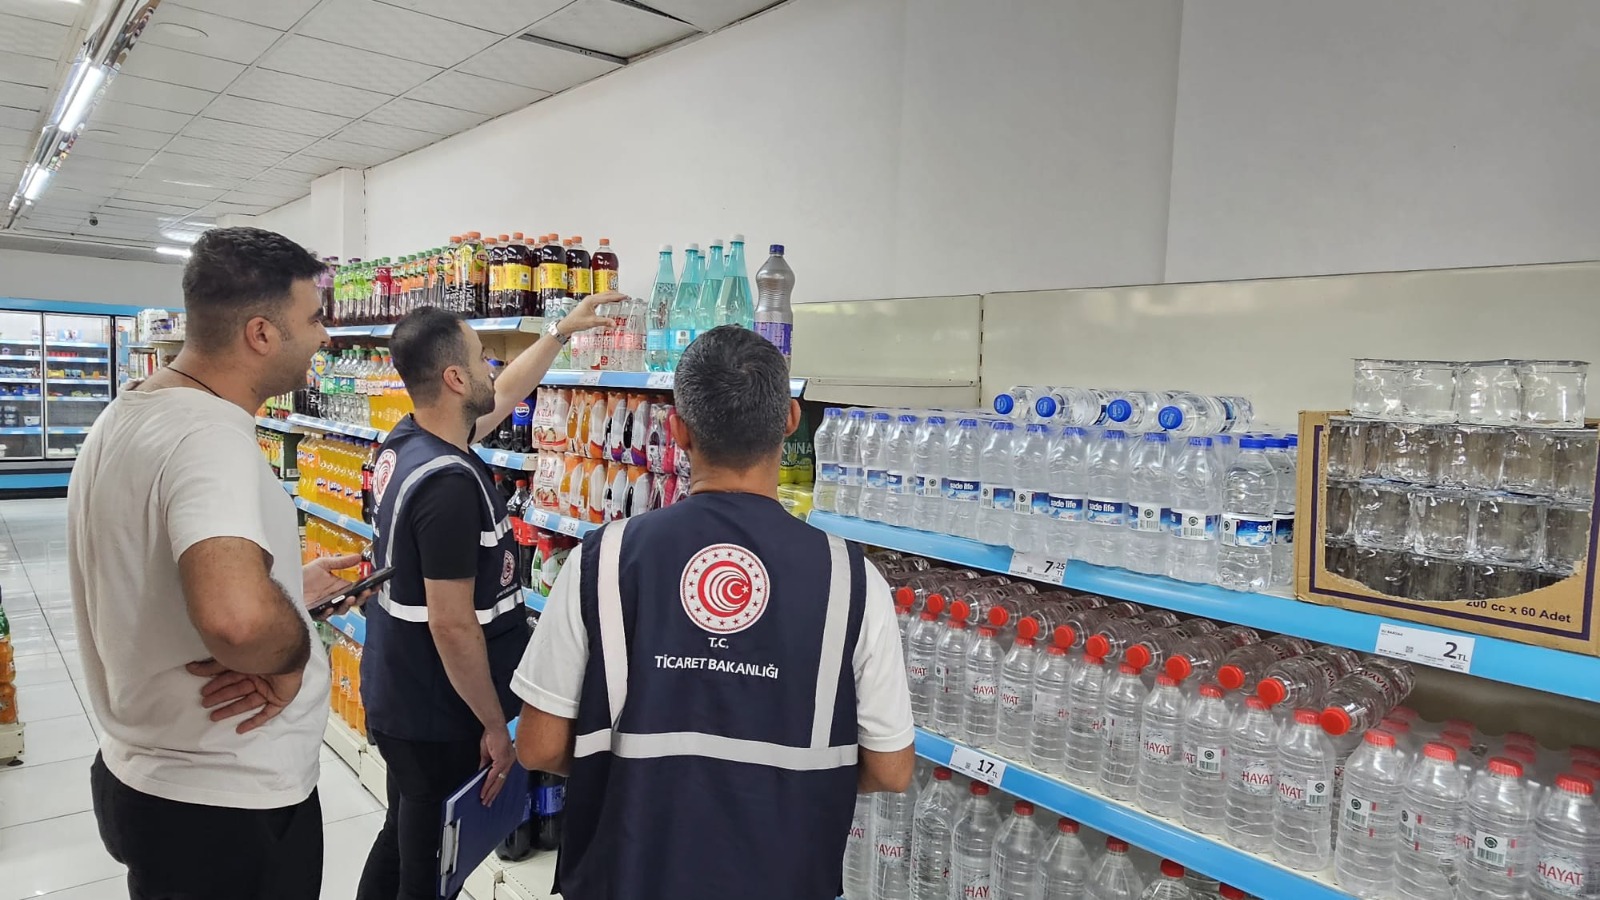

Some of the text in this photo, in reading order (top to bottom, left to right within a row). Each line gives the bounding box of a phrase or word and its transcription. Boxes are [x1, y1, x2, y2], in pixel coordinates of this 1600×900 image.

[782, 440, 813, 455] KMİNA
[949, 482, 974, 491] sade life
[1050, 499, 1077, 510] sade life
[1089, 503, 1115, 513] sade life
[1257, 524, 1272, 532] sad
[1491, 603, 1506, 612] cc
[1509, 606, 1517, 615] x
[1521, 606, 1536, 617] 60
[1539, 609, 1572, 624] Adet
[708, 637, 729, 649] T.C.
[1443, 641, 1458, 659] 2
[1457, 653, 1468, 662] TL
[654, 654, 778, 679] TİCARET BAKANLIĞI
[1143, 740, 1173, 756] HAYAT
[977, 759, 995, 774] 17
[1241, 770, 1275, 785] HAYAT
[1538, 860, 1584, 886] HAYAT
[965, 886, 990, 899] HAY
